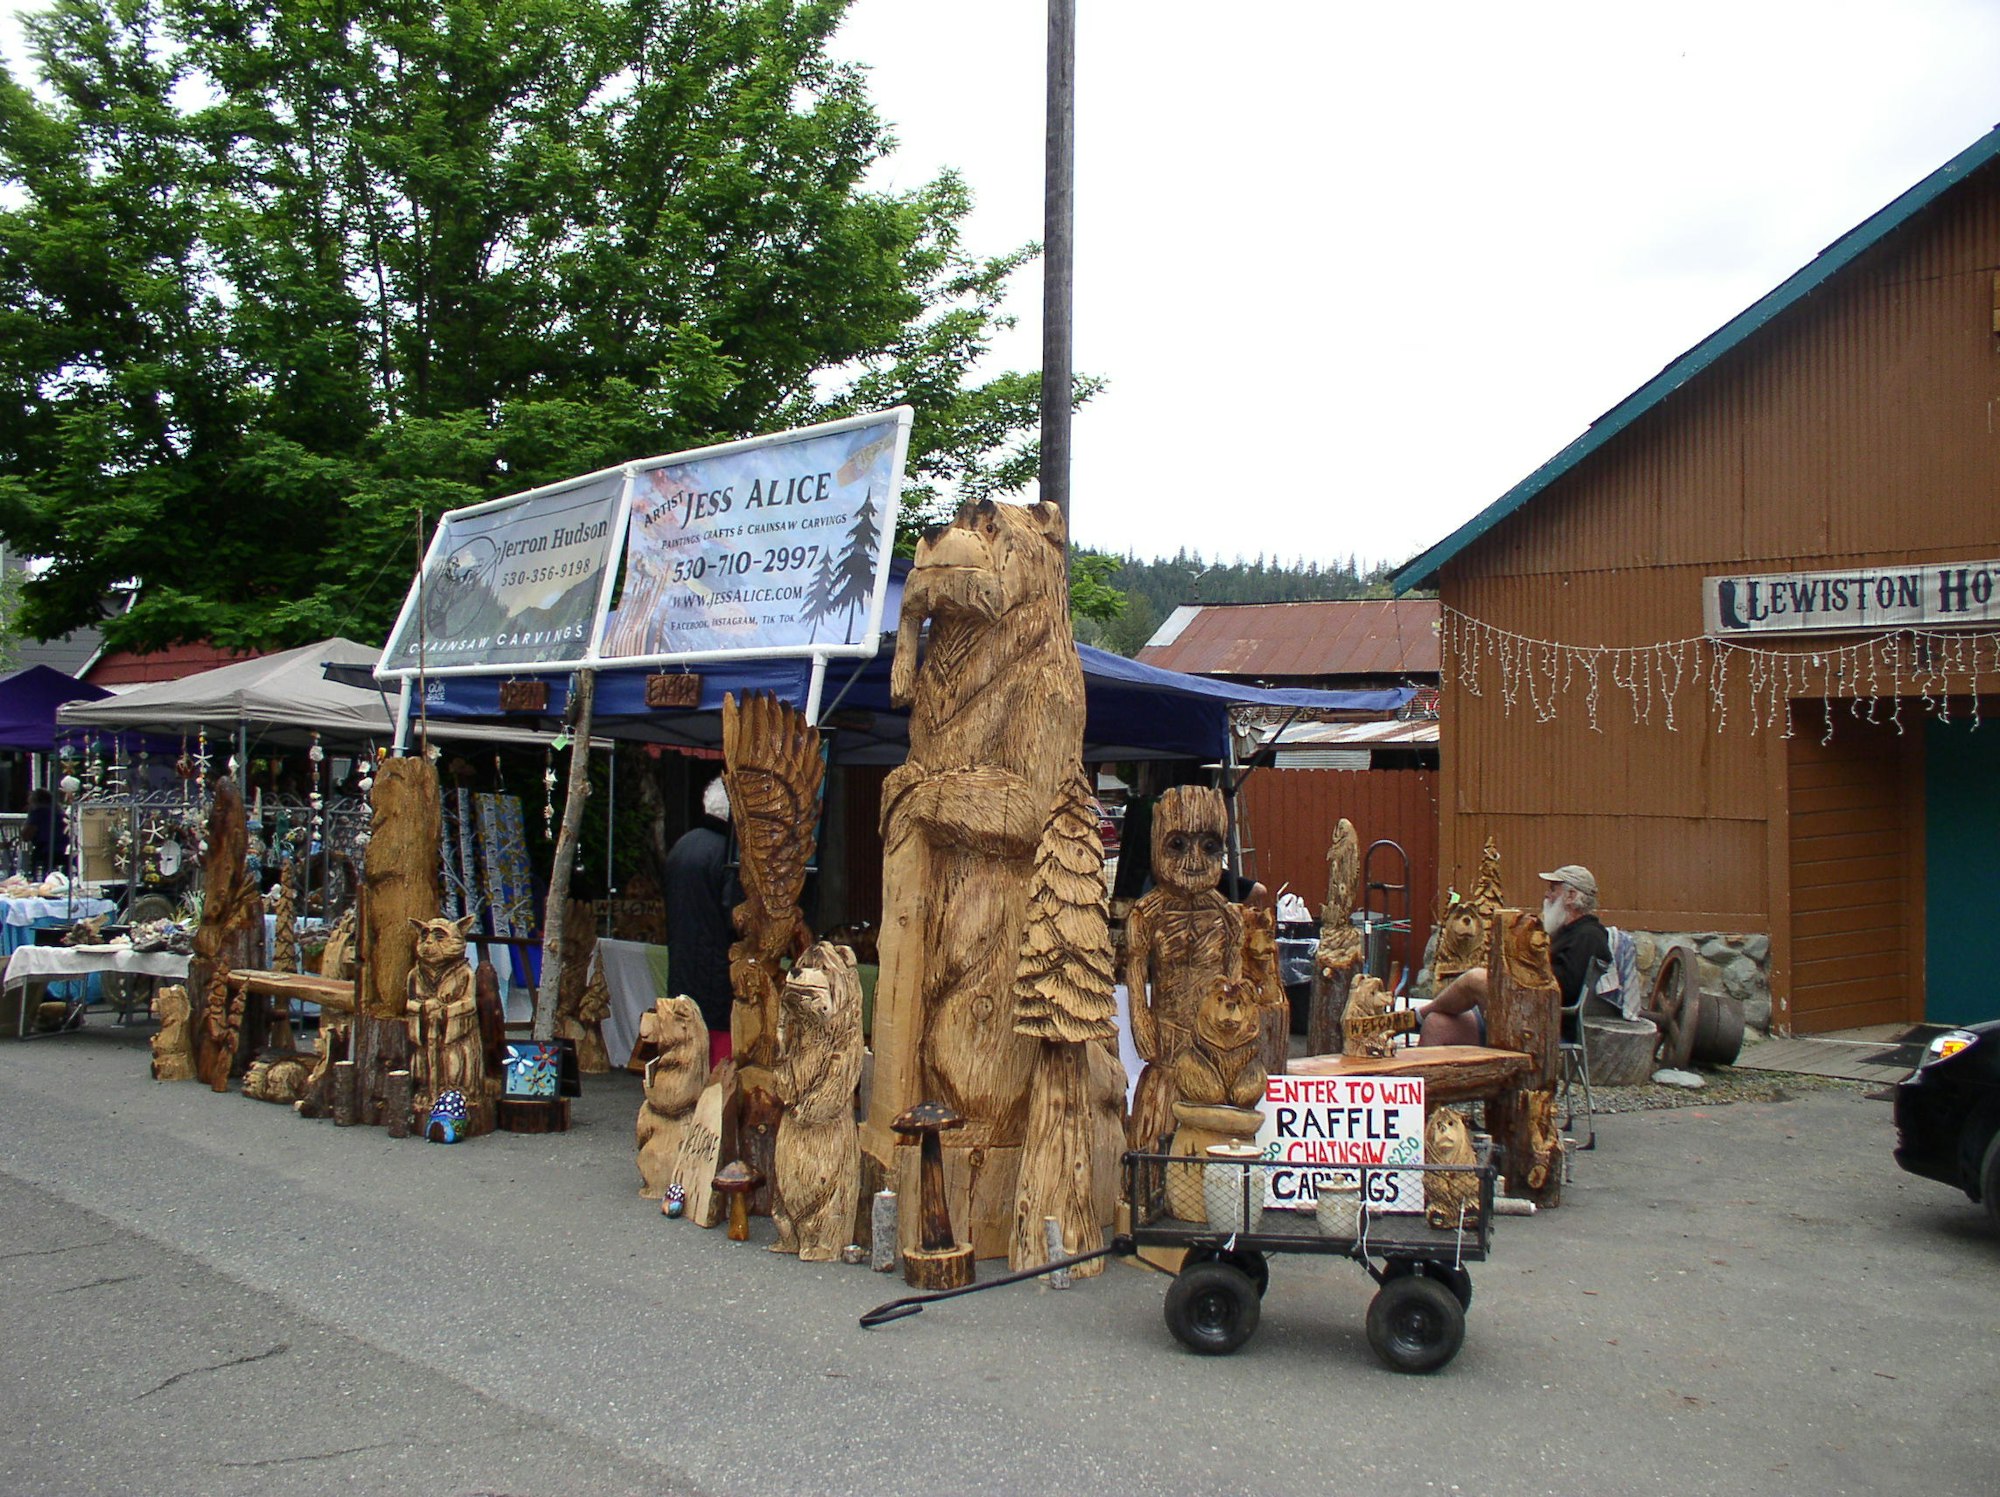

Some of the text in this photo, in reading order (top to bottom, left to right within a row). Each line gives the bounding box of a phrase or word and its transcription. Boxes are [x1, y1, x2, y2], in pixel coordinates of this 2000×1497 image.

[643, 490, 686, 528] ARTIST
[681, 472, 832, 529] JESS ALICE
[498, 520, 608, 564] Jerron Hudson
[703, 528, 735, 541] CRAFTS
[747, 520, 798, 535] CHAINSAW
[801, 513, 847, 529] CARVINGS
[501, 558, 591, 587] 530-356-9198
[672, 545, 820, 583] 530-710-2997
[1747, 574, 1920, 622] LEWISTON
[496, 625, 584, 646] CARVINGS
[1265, 1079, 1422, 1105] ENTER TO WIN
[1276, 1108, 1400, 1140] RAFFLE
[1272, 1170, 1400, 1203] CARGS
